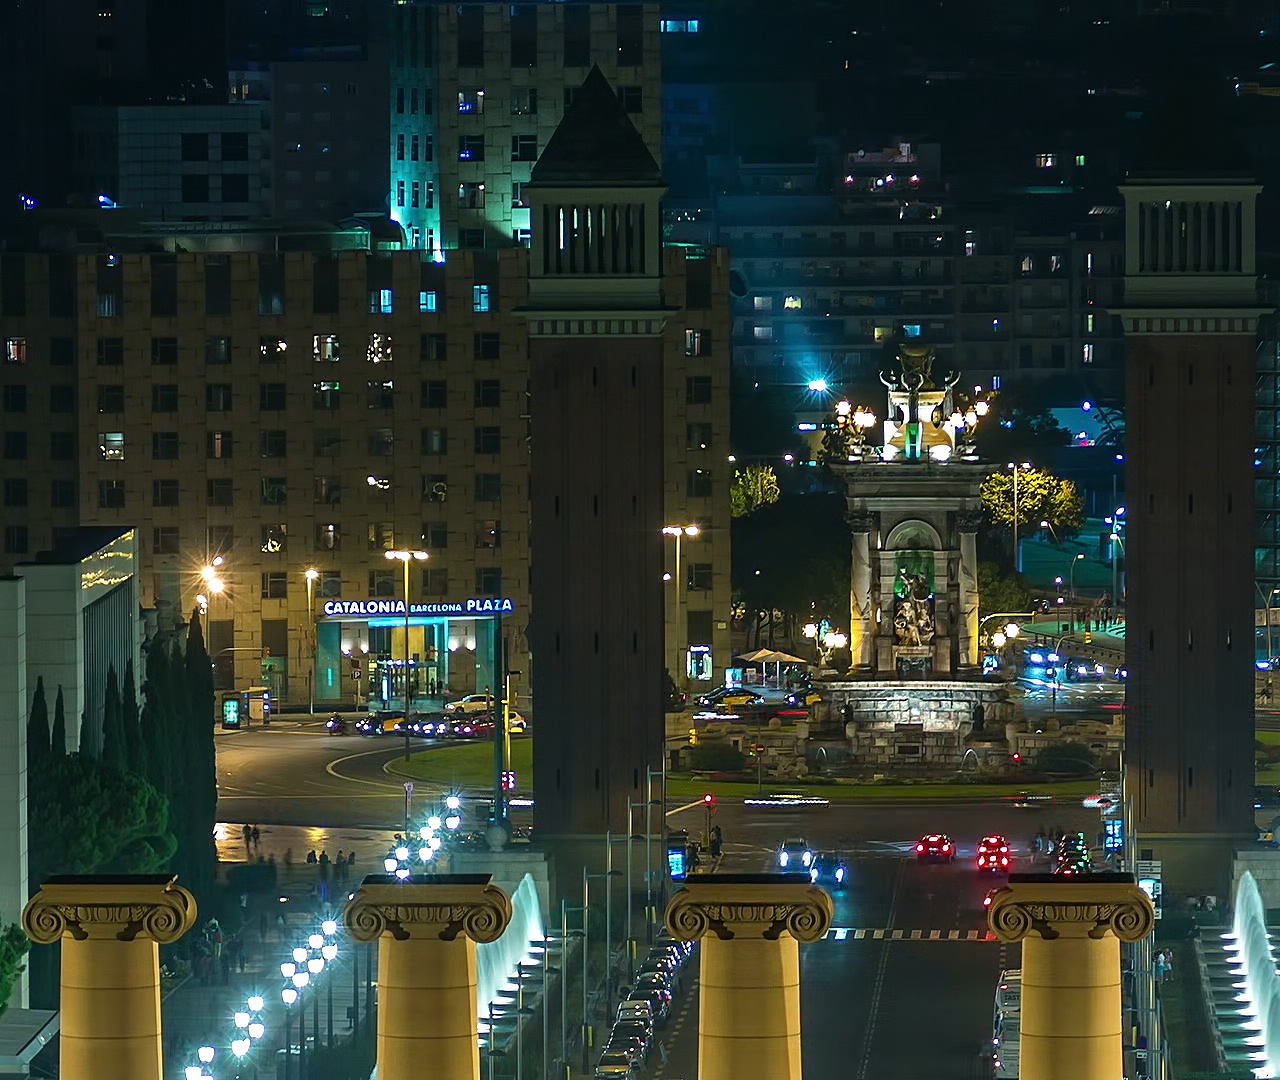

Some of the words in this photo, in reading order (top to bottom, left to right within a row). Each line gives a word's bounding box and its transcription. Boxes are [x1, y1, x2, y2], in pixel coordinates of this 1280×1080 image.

[324, 600, 406, 615] CATALONIA
[410, 603, 463, 613] BARCELONA
[466, 599, 513, 612] PLAZA
